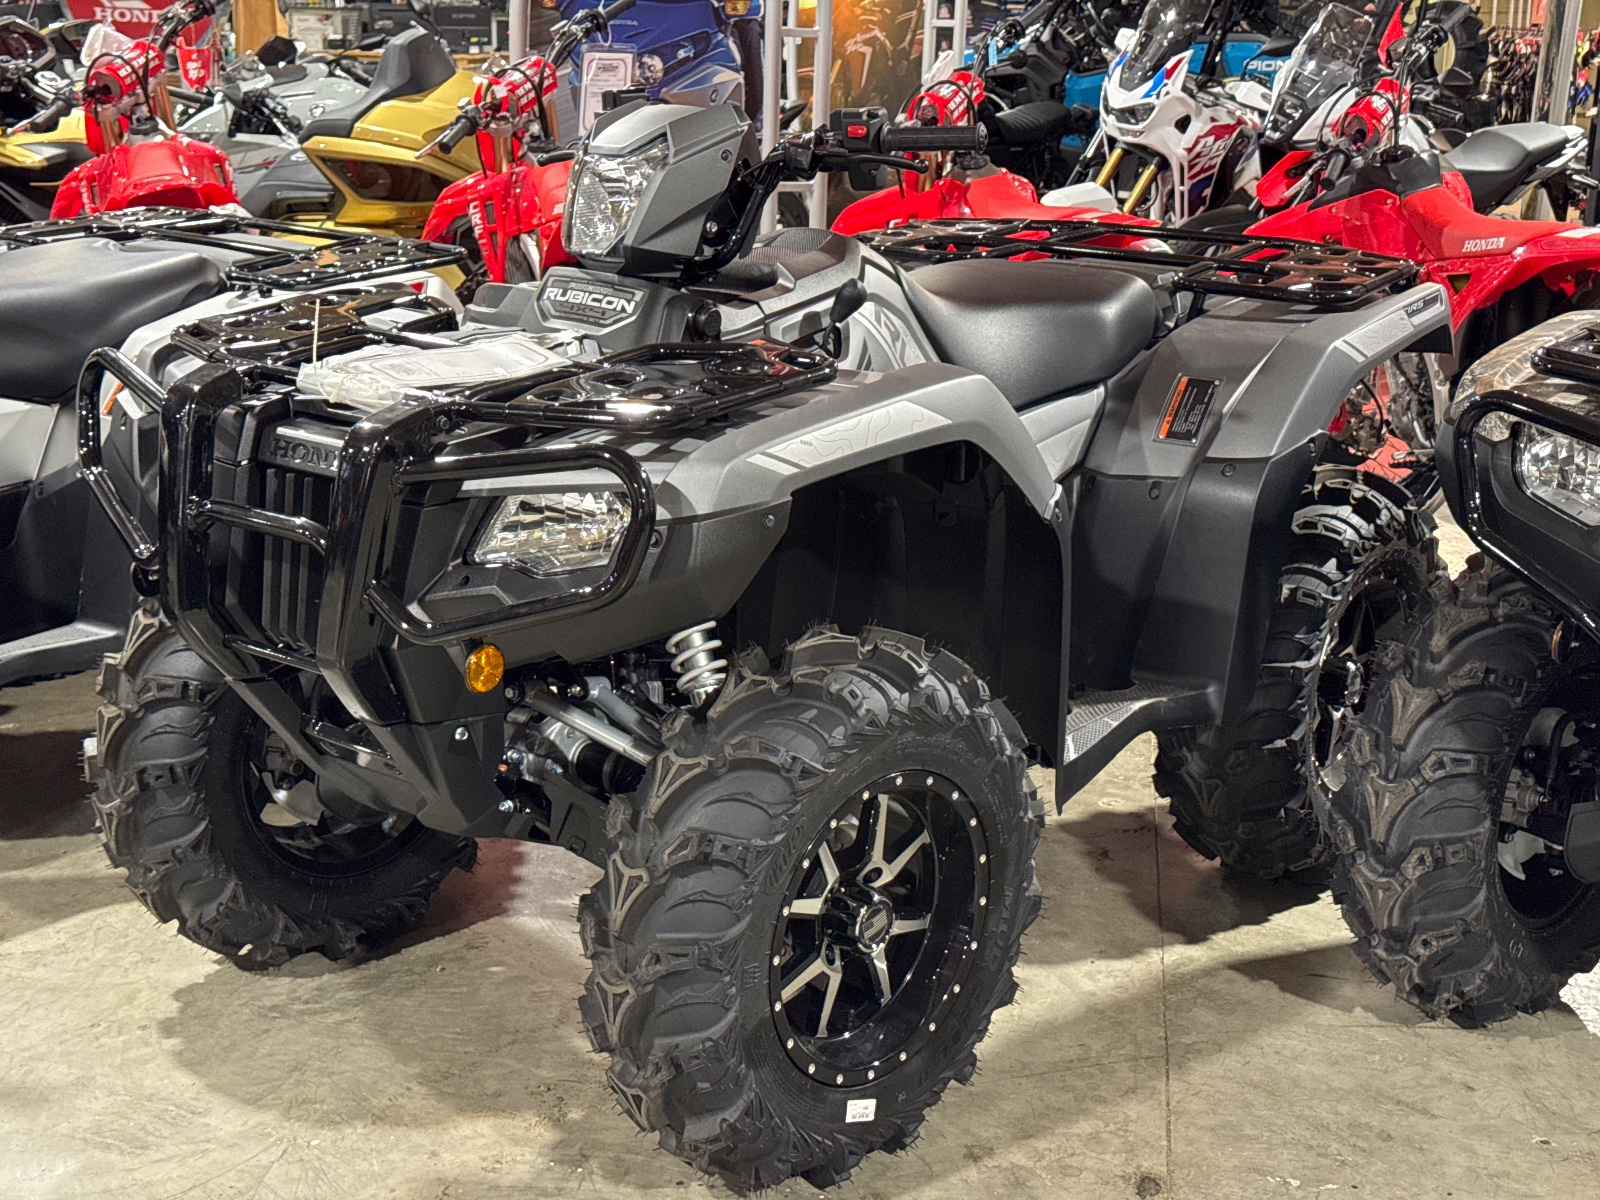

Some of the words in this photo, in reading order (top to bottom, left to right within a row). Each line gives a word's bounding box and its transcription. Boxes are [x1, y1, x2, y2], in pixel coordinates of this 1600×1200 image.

[1246, 60, 1285, 72] PION
[1462, 236, 1506, 252] HONDA
[543, 287, 636, 314] RUBICON
